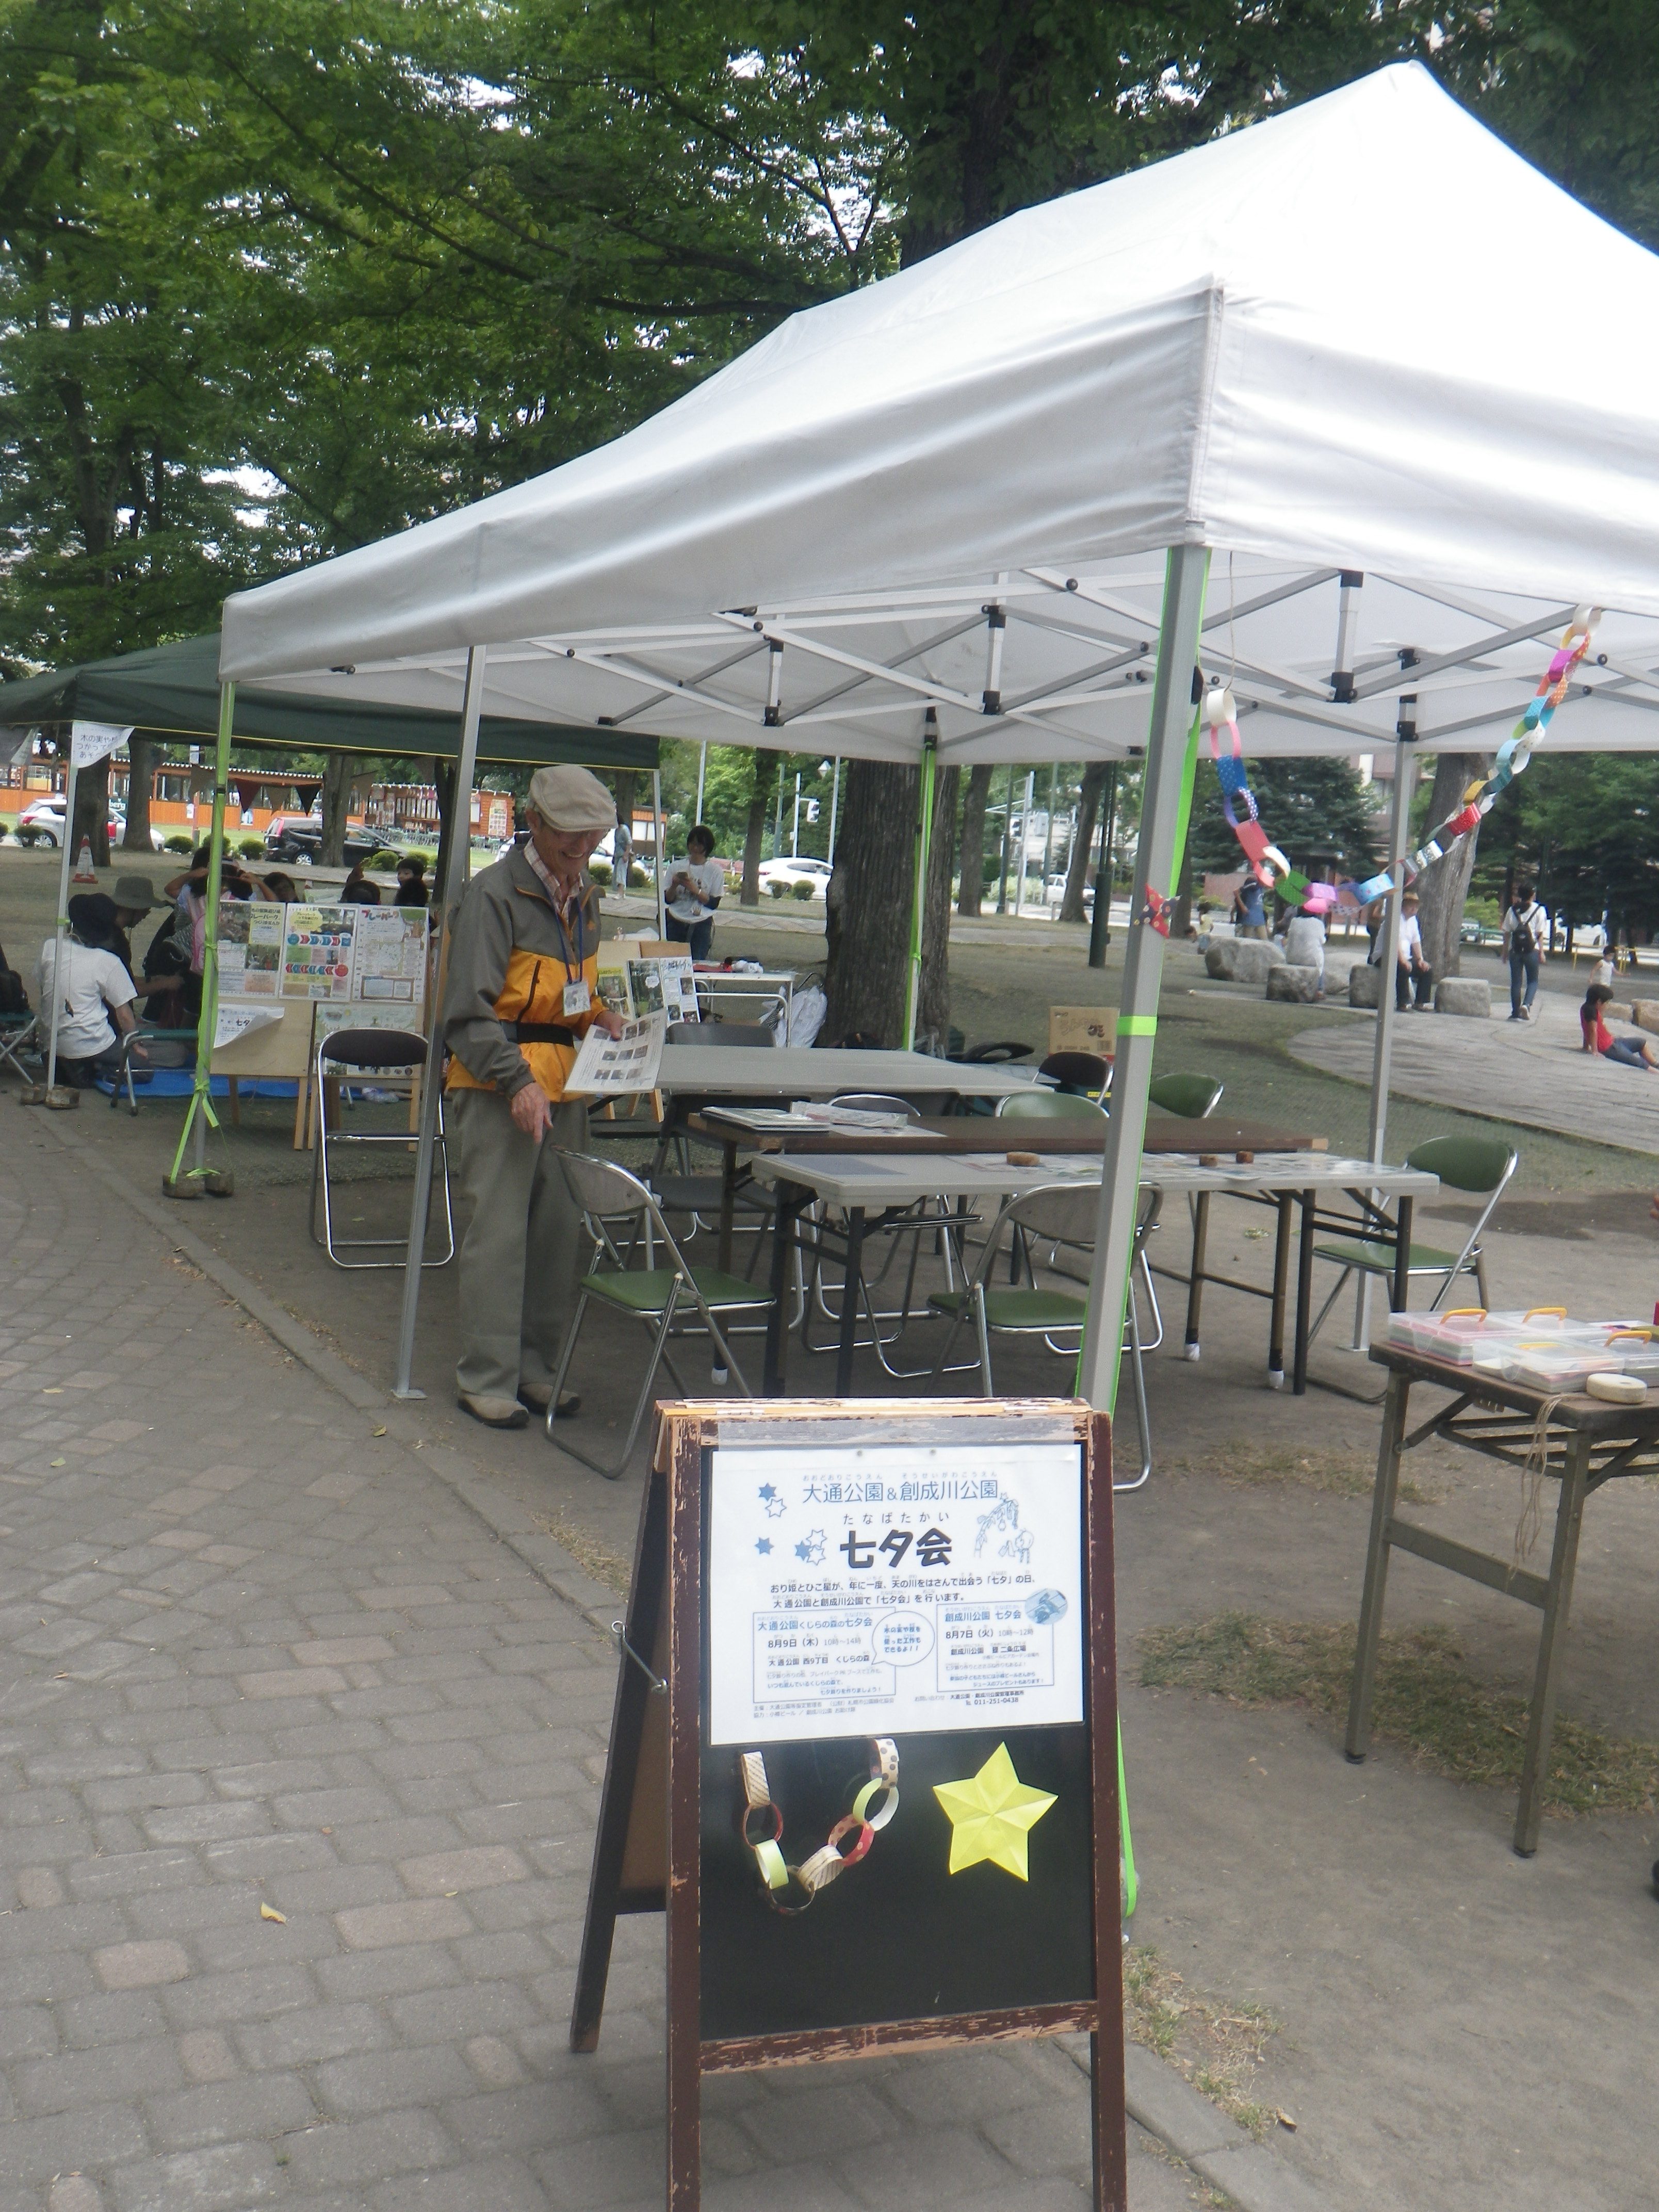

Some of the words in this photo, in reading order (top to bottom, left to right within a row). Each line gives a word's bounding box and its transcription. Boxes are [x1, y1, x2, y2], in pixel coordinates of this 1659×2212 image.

[803, 1479, 998, 1503] 大通公園&創成川公園
[843, 1512, 950, 1525] たなばたかい
[840, 1527, 952, 1569] 七夕会
[945, 1611, 990, 1622] 創成川公園
[995, 1609, 1022, 1620] 七夕会
[946, 1629, 994, 1639] 8月7日（火）
[768, 1637, 819, 1648] 8月9日（木）
[769, 1657, 800, 1667] 大通公園
[803, 1656, 828, 1665] 西9丁目
[836, 1654, 869, 1663] くじらの森
[974, 1697, 1019, 1705] 011-251-0438
